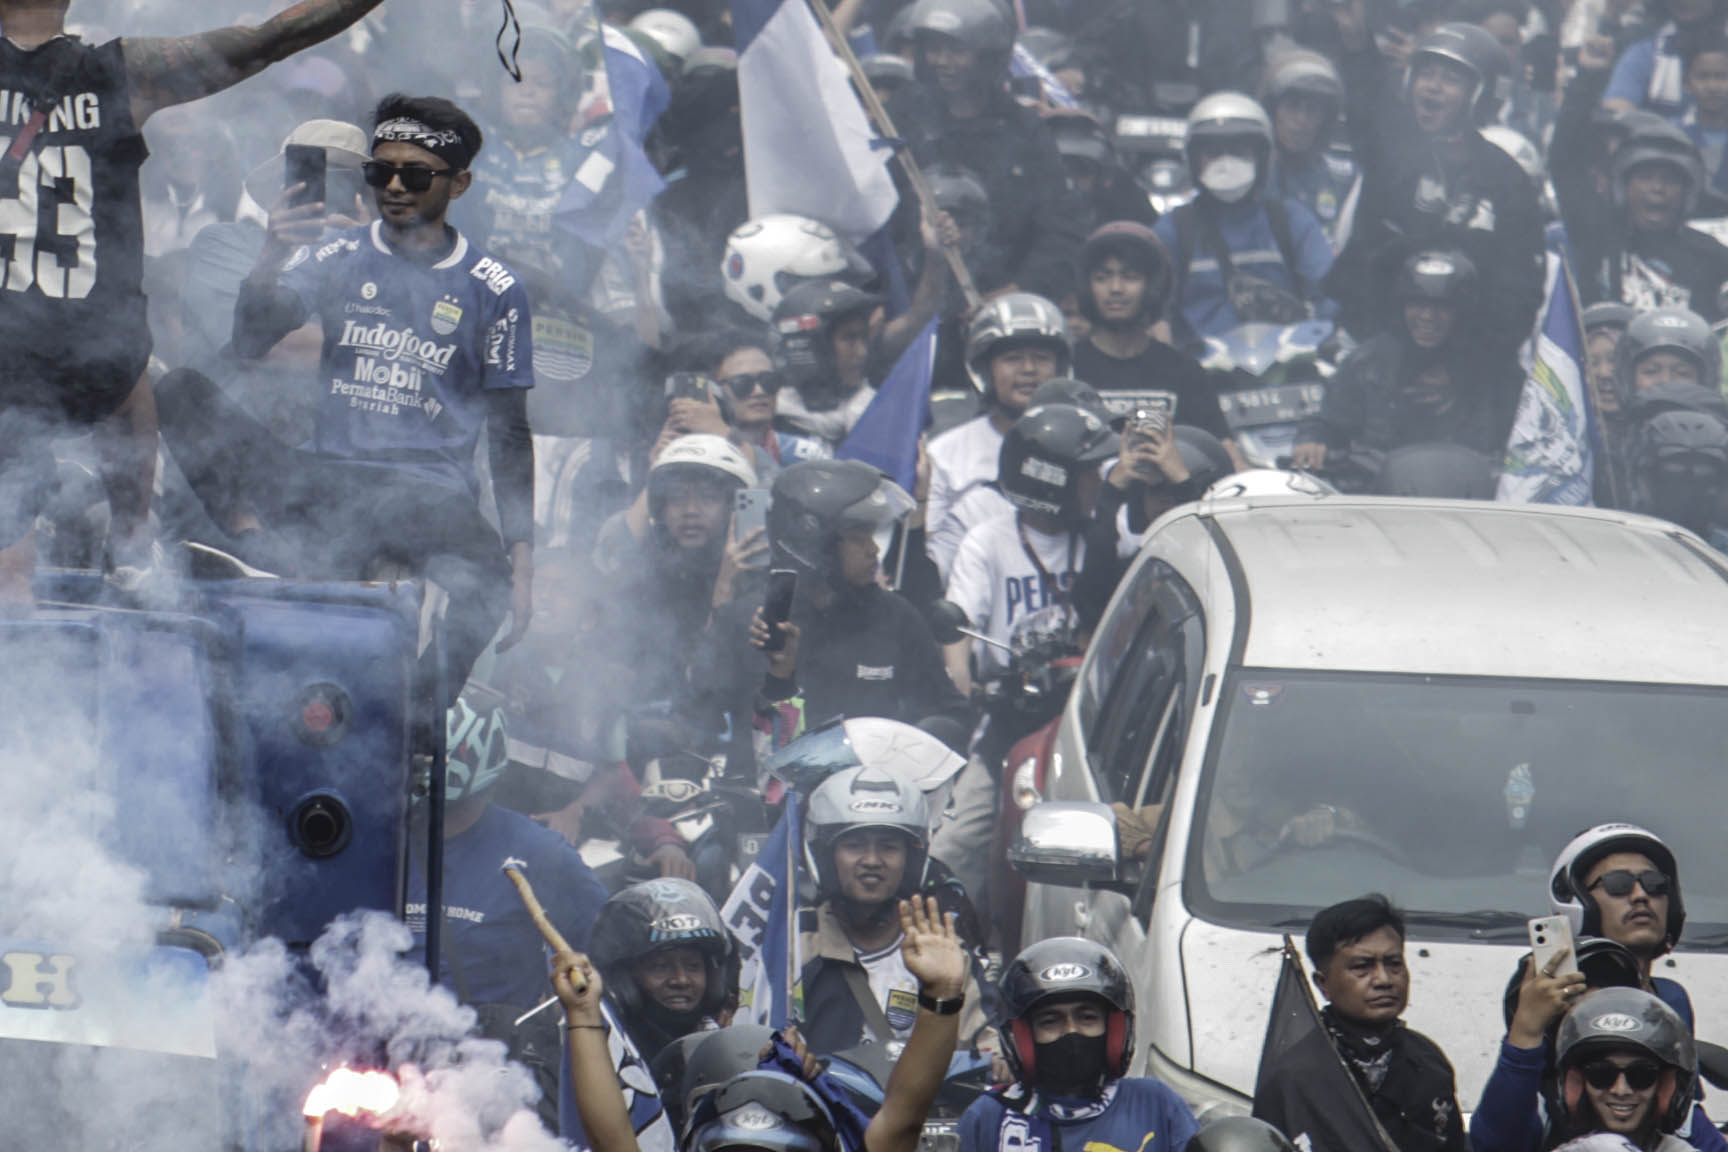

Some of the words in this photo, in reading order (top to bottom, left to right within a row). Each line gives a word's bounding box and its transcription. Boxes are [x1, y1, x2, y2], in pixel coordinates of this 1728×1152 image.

[470, 256, 517, 294] PRIA
[338, 319, 458, 367] Indofood
[353, 356, 423, 392] Mobil
[332, 377, 424, 409] PermataBank
[348, 395, 401, 416] Syariah
[443, 904, 485, 923] HOME
